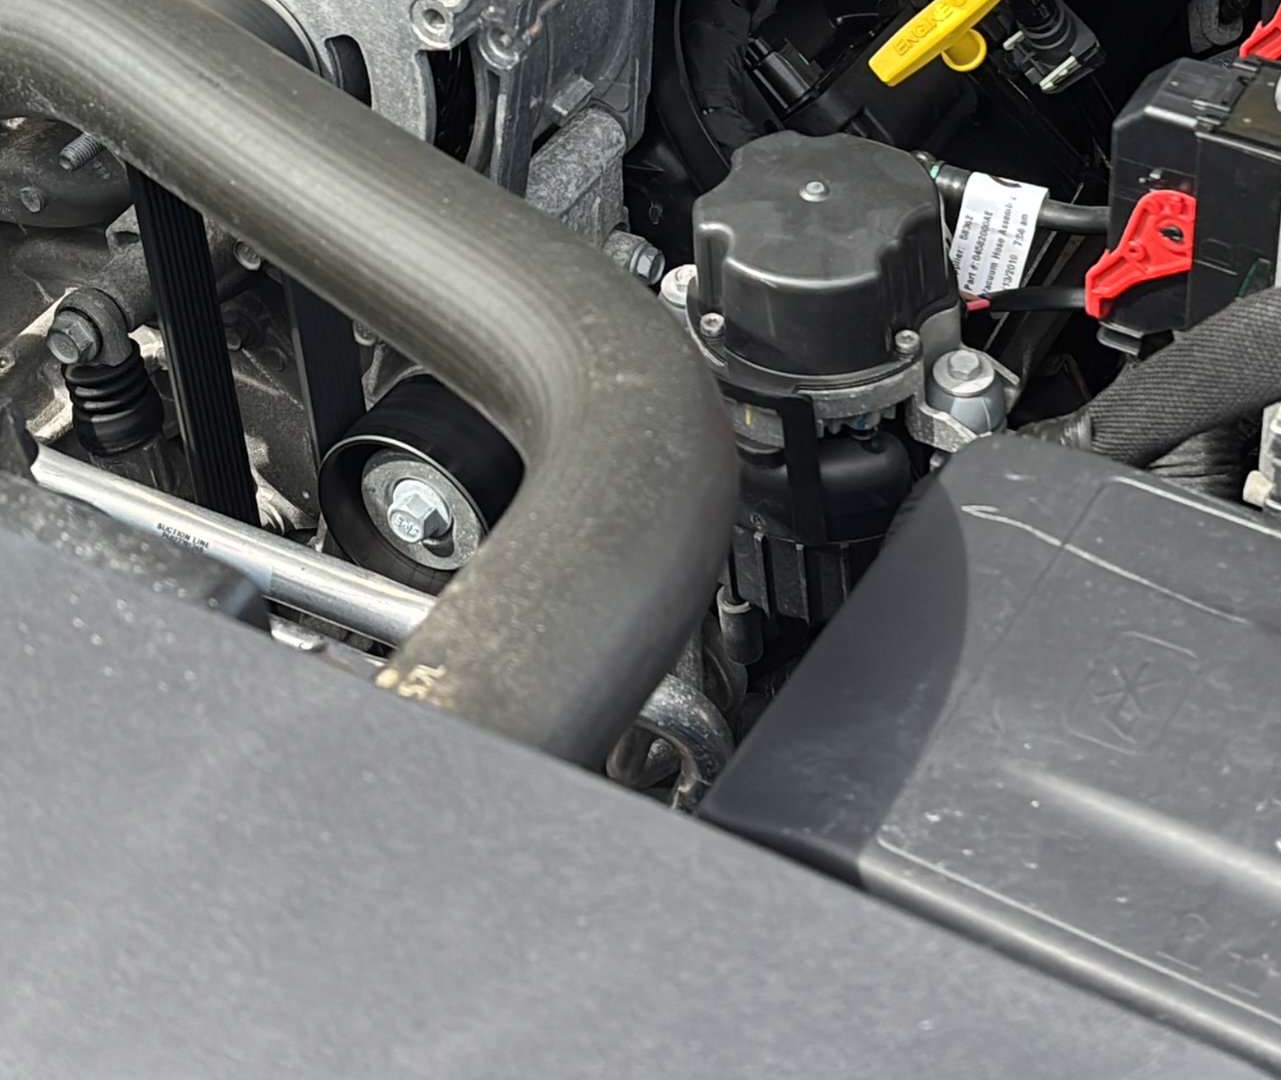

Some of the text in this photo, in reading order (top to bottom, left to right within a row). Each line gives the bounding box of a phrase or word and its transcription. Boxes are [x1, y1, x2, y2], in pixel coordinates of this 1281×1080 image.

[895, 2, 954, 56] ENGINE
[1020, 213, 1029, 226] am
[963, 271, 977, 291] Part
[982, 262, 998, 294] Vacuum
[991, 237, 1005, 260] Hose
